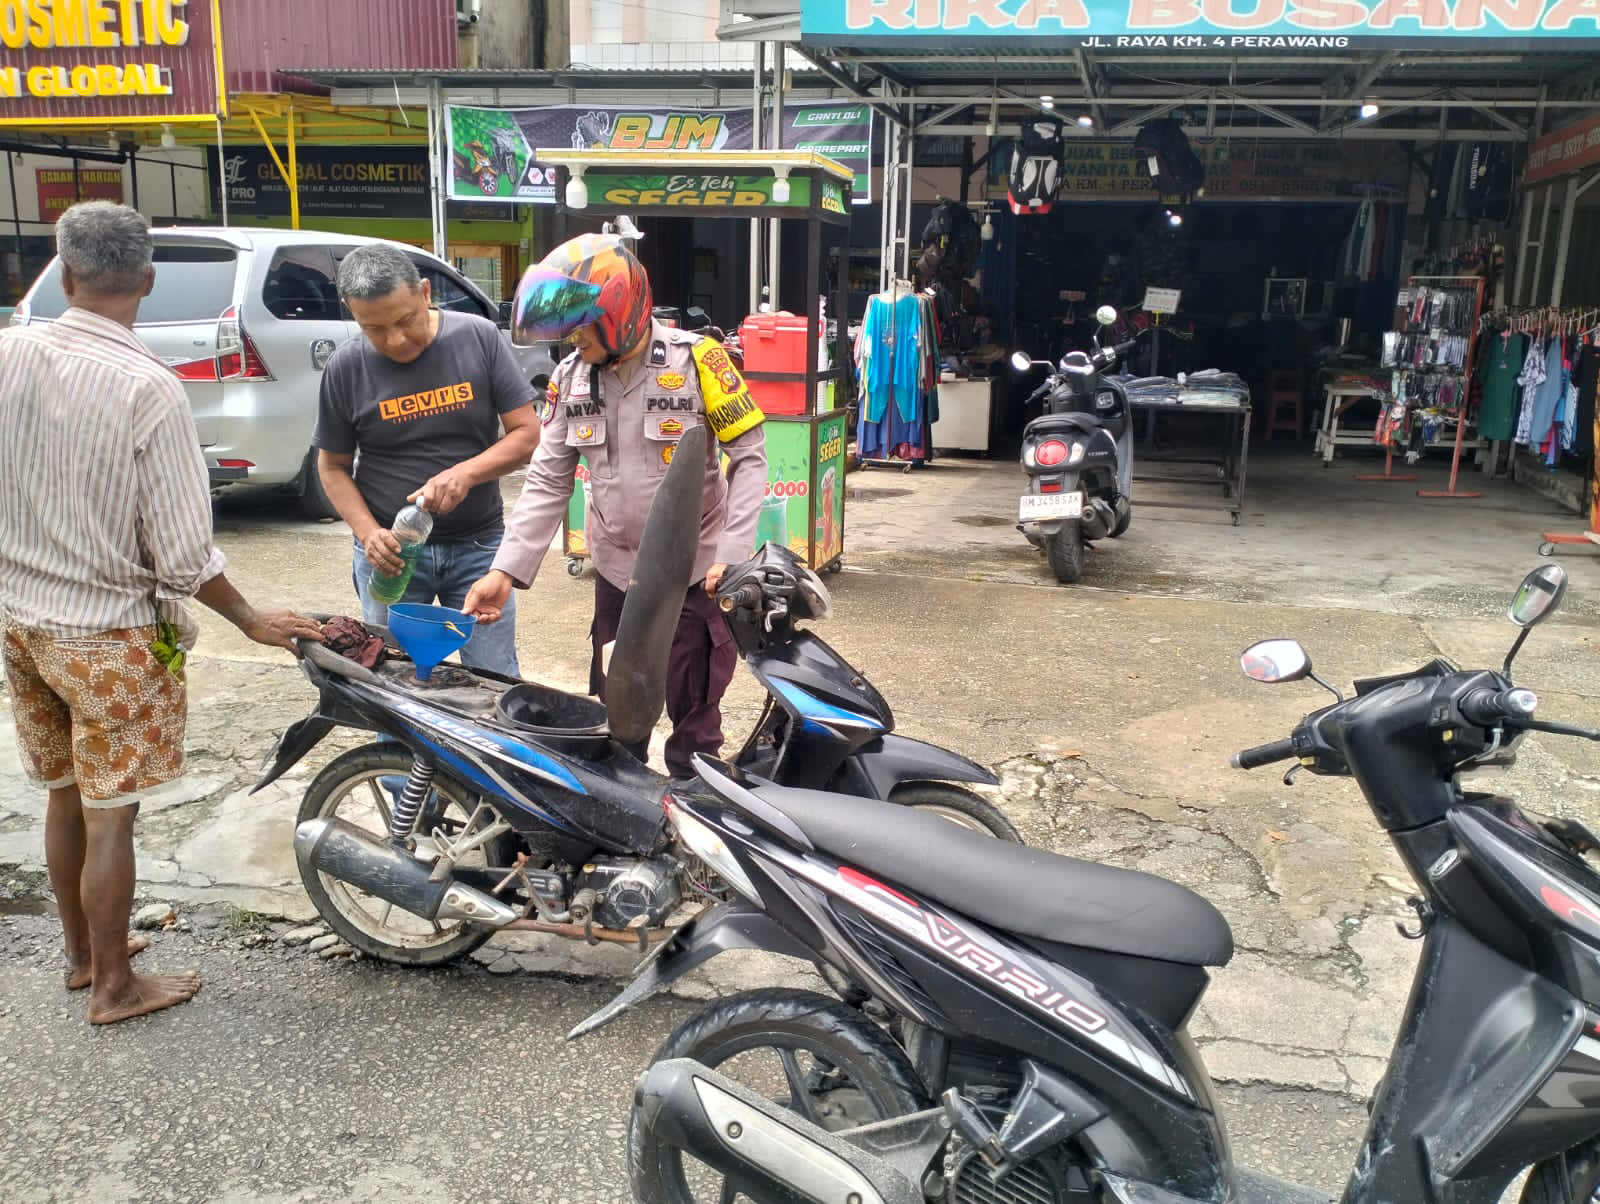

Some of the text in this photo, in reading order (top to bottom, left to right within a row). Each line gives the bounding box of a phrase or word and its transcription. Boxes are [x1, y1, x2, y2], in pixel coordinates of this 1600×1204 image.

[1081, 36, 1349, 47] JL. RAYA KM. 4 PERAWANG
[27, 63, 173, 97] GLOBAL
[807, 111, 861, 121] GANTI OLI
[609, 114, 724, 149] BJM
[331, 163, 425, 182] COSMETIK
[666, 175, 735, 192] Es Teh
[232, 187, 256, 199] PRO
[647, 397, 694, 411] POLRI
[820, 437, 841, 464] SEGER
[922, 909, 1109, 1034] VARIO
